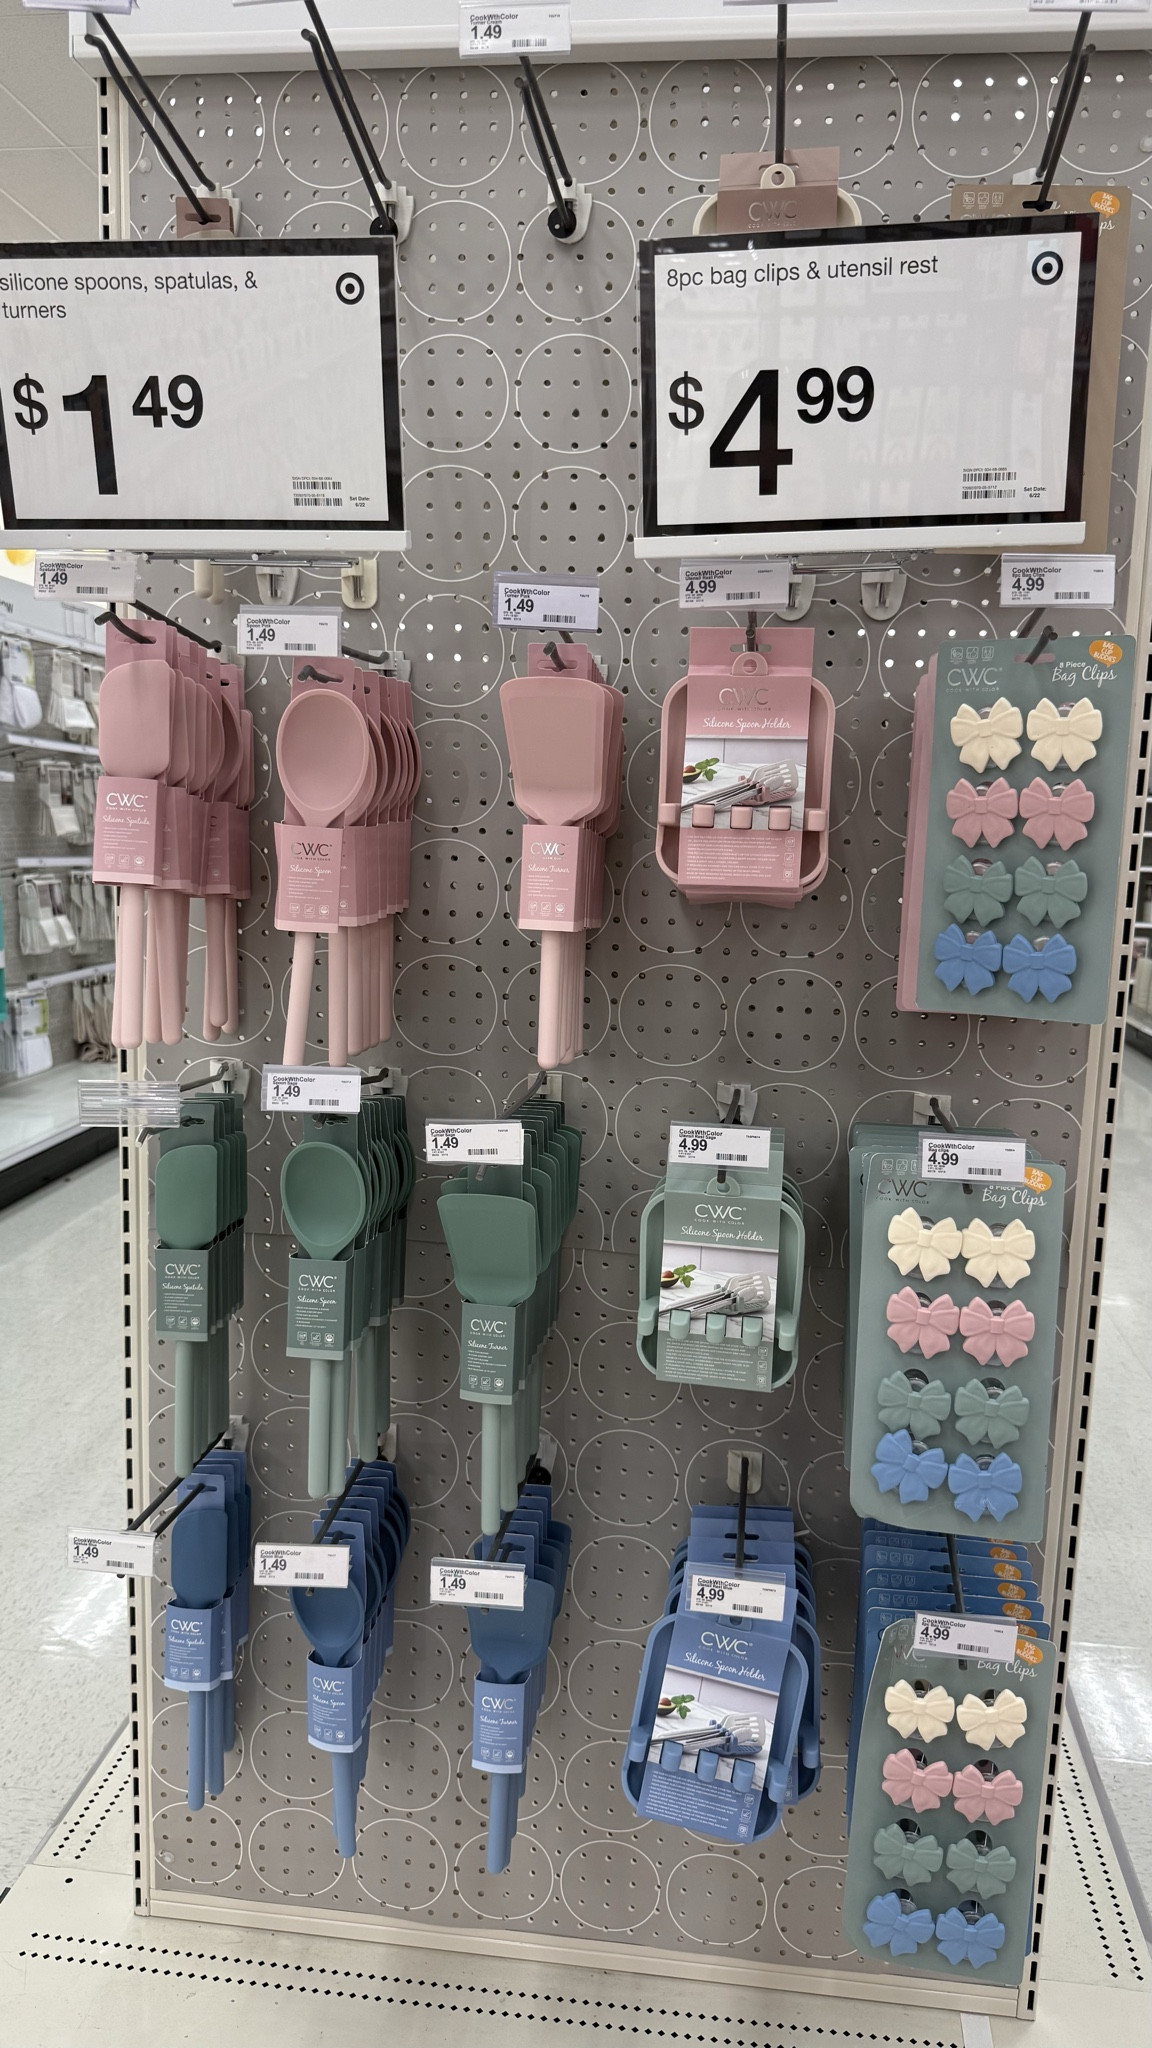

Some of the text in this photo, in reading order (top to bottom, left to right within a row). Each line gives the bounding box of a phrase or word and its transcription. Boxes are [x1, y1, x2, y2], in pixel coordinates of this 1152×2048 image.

[471, 25, 502, 39] 1.49
[749, 200, 798, 221] CWC
[667, 255, 939, 291] 8pc bag clips & utensil rest
[0, 271, 258, 295] silicone spoons, spatulas, &
[2, 303, 67, 319] turners
[13, 373, 204, 495] $ 1 49
[668, 365, 875, 496] $ 4 99
[40, 572, 68, 585] 1.49
[1012, 577, 1044, 591] 4.99
[685, 580, 716, 593] 4.99
[504, 598, 534, 612] 1.49
[247, 628, 276, 641] 1.49
[1102, 641, 1114, 650] BAG
[947, 667, 997, 686] CWC
[1052, 664, 1117, 688] Bag Clips
[719, 688, 769, 705] CWC
[703, 717, 791, 733] Silicone Spoon Holder
[106, 793, 145, 808] CWC
[291, 842, 329, 857] CWC
[531, 842, 567, 856] CWC
[290, 865, 332, 877] Silicone Spoon
[273, 1085, 301, 1097] 1.49
[432, 1137, 459, 1149] 1.49
[679, 1138, 708, 1151] 4.99
[928, 1152, 959, 1166] 4.99
[877, 1179, 928, 1198] CWC
[982, 1187, 1047, 1213] Bag Clips
[694, 1204, 742, 1220] CWC
[680, 1225, 764, 1242] Silicone Spoon Holder
[165, 1263, 198, 1275] CWC
[298, 1274, 334, 1288] CWC
[297, 1295, 336, 1307] Silicone Spoon
[470, 1319, 504, 1333] CWC
[468, 1340, 508, 1351] Silicone Turner
[74, 1545, 99, 1558] 1.49
[260, 1558, 287, 1571] 1.49
[440, 1577, 466, 1589] 1.49
[696, 1587, 725, 1601] 4.99
[171, 1619, 200, 1632] CWC
[921, 1626, 950, 1640] 4.99
[701, 1632, 749, 1655] CWC
[683, 1651, 766, 1681] Silicone Spoon Holder
[977, 1660, 1038, 1682] Bag Clips
[312, 1676, 342, 1692] CWC
[481, 1696, 513, 1710] CWC
